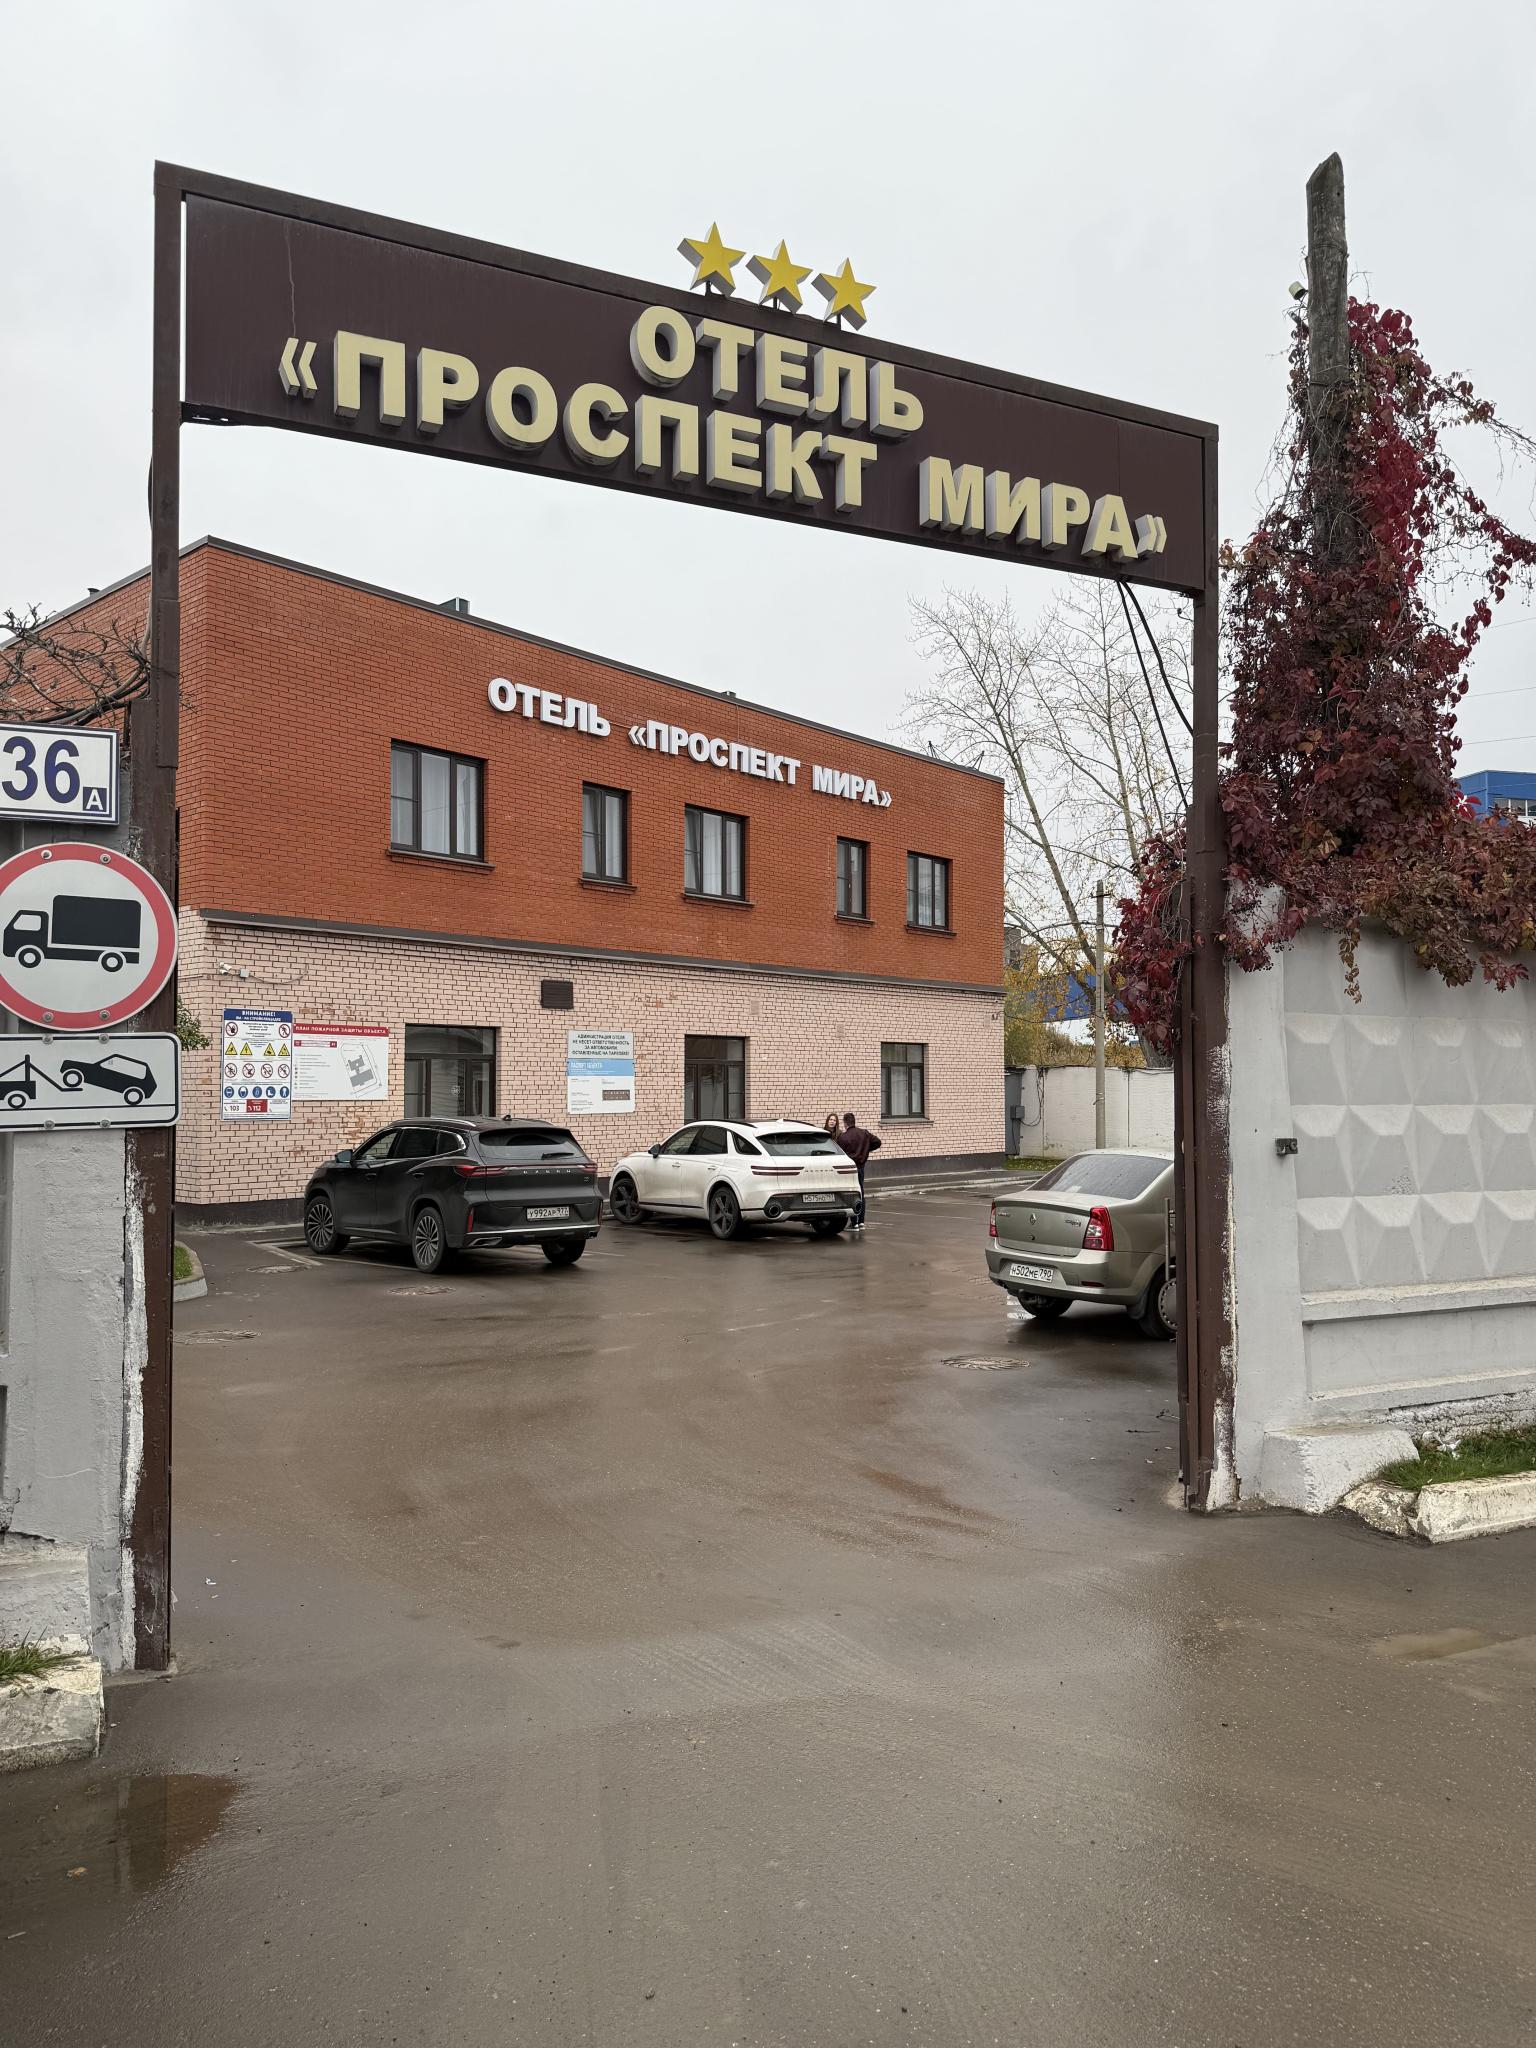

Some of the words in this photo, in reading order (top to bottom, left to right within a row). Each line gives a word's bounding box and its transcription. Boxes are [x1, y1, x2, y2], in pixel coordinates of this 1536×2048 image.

[630, 305, 925, 436] ОТЕЛЬ
[279, 329, 878, 512] «ПРОСПЕКТ
[919, 456, 1167, 560] МИРА»
[1, 735, 81, 804] 36
[487, 677, 611, 737] ОТЕЛЬ
[628, 719, 801, 785] «ПРОСПЕКТ
[812, 765, 893, 808] МИРА»
